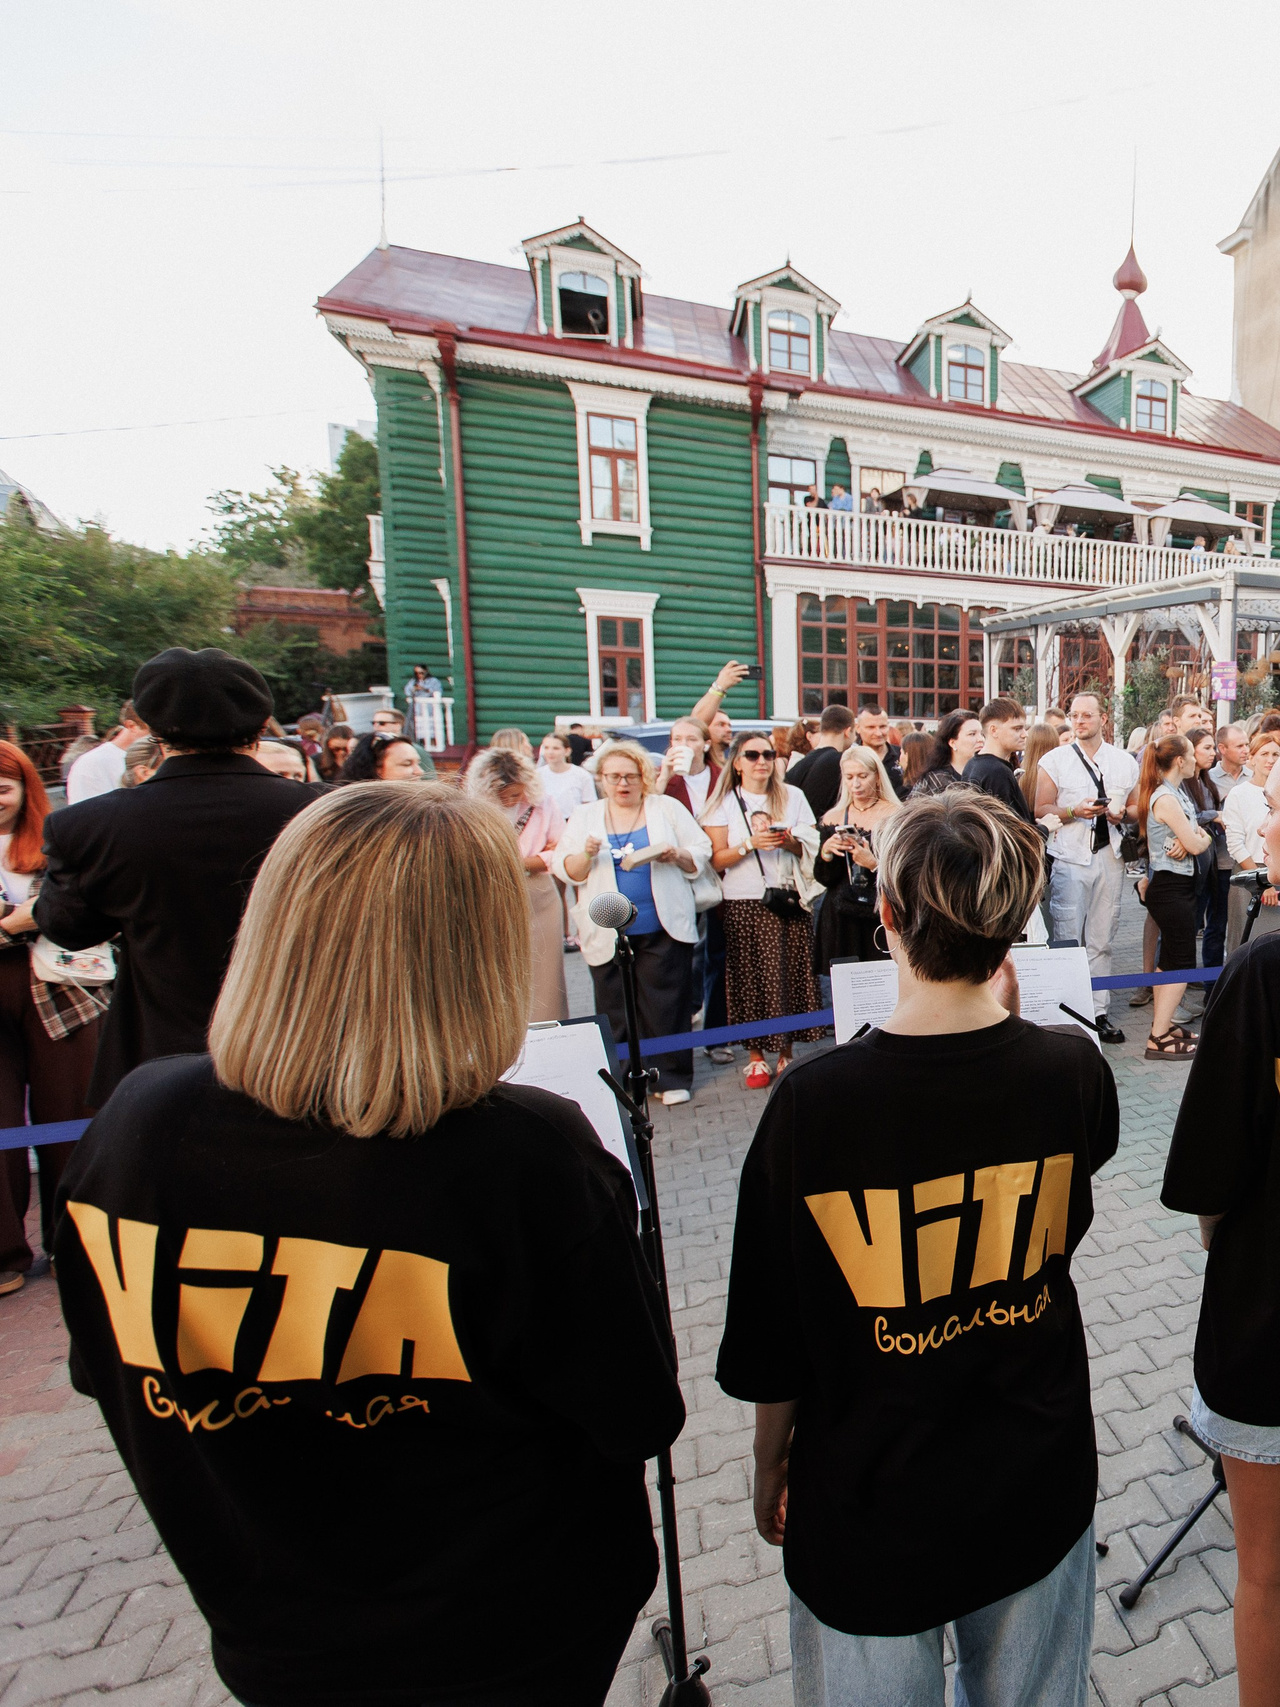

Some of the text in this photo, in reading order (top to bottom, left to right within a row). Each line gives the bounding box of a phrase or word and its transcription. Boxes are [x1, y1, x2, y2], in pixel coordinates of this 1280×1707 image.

[66, 1200, 472, 1386] ViTA
[804, 1153, 1074, 1309] ViTA
[874, 1283, 1052, 1355] вокальная
